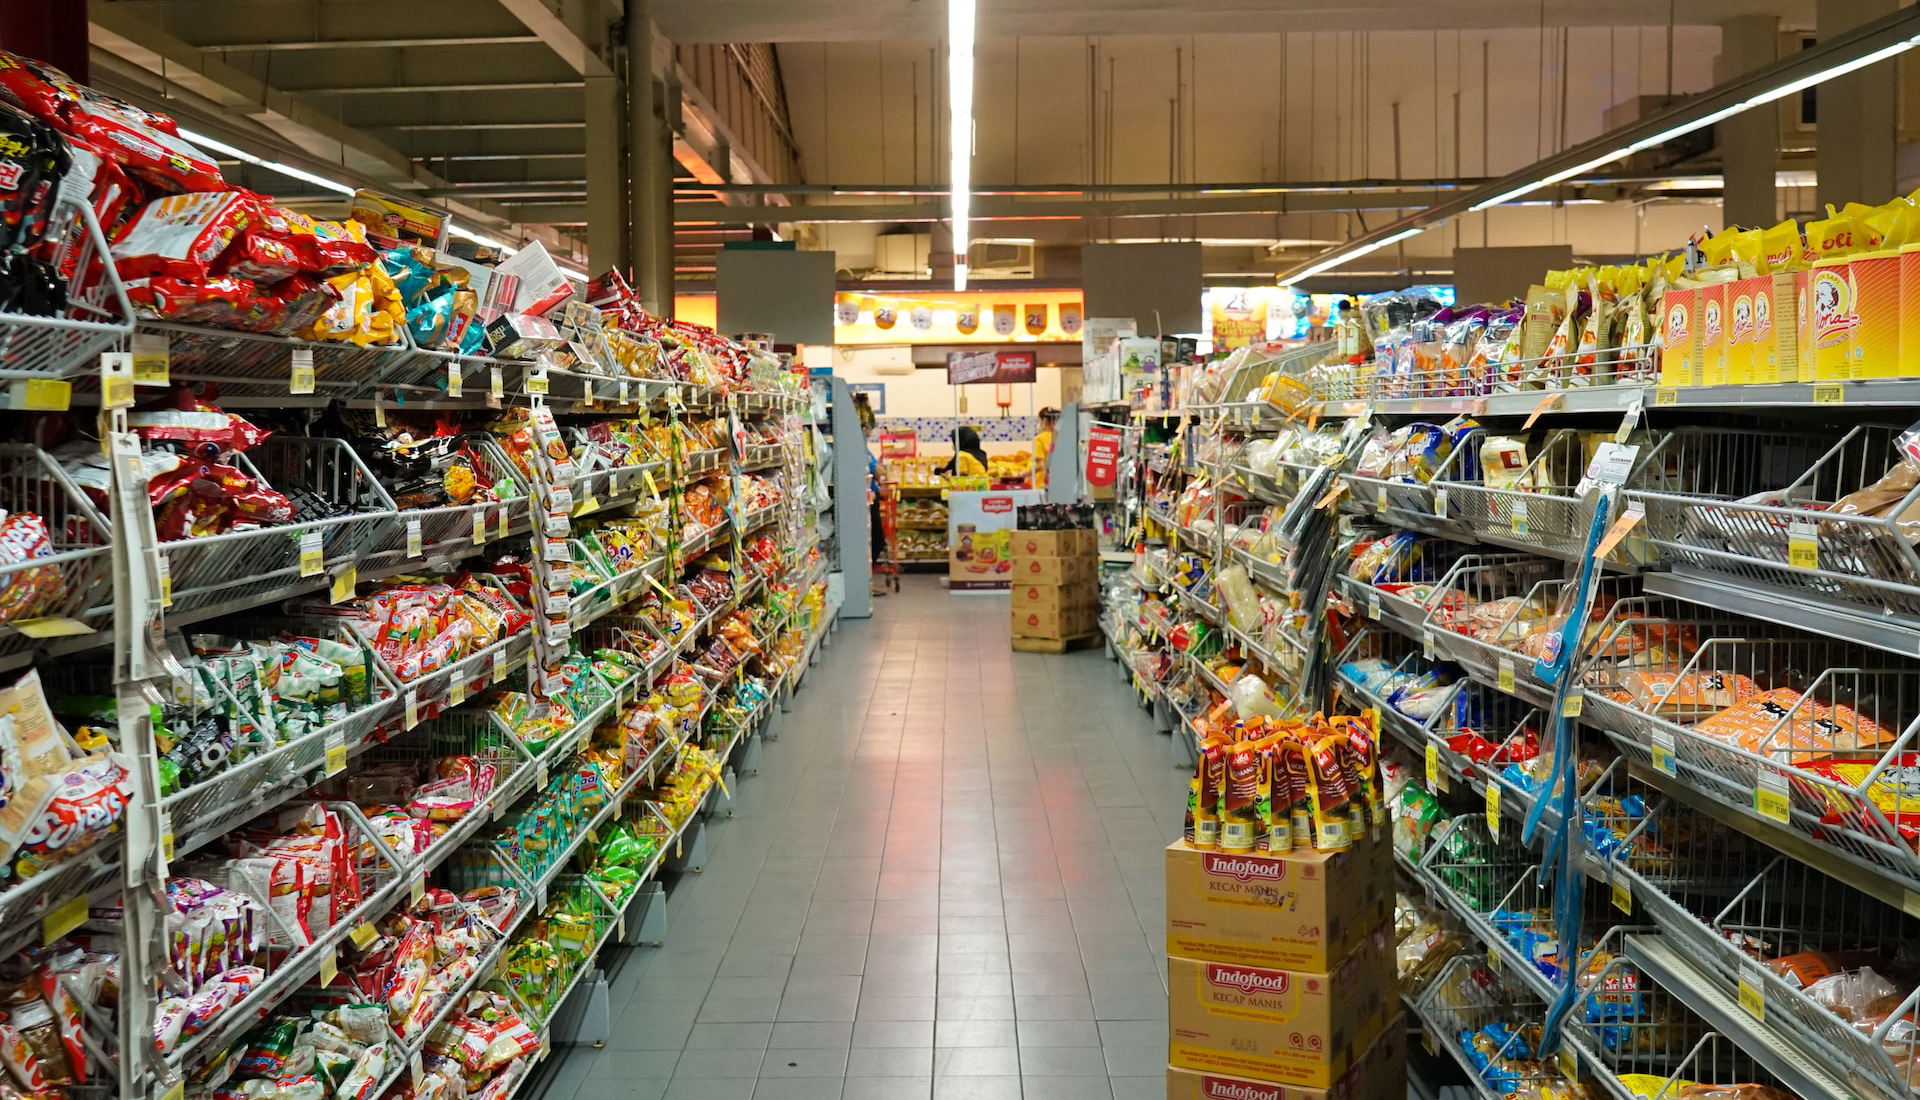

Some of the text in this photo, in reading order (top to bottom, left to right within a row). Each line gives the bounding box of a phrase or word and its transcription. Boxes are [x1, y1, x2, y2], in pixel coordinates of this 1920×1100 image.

[1211, 857, 1279, 879] Indofood
[1210, 881, 1242, 892] KECAP
[1215, 969, 1283, 990] Indofood
[1213, 992, 1283, 1009] KECAP MANIS
[1211, 1081, 1279, 1100] Indofood
